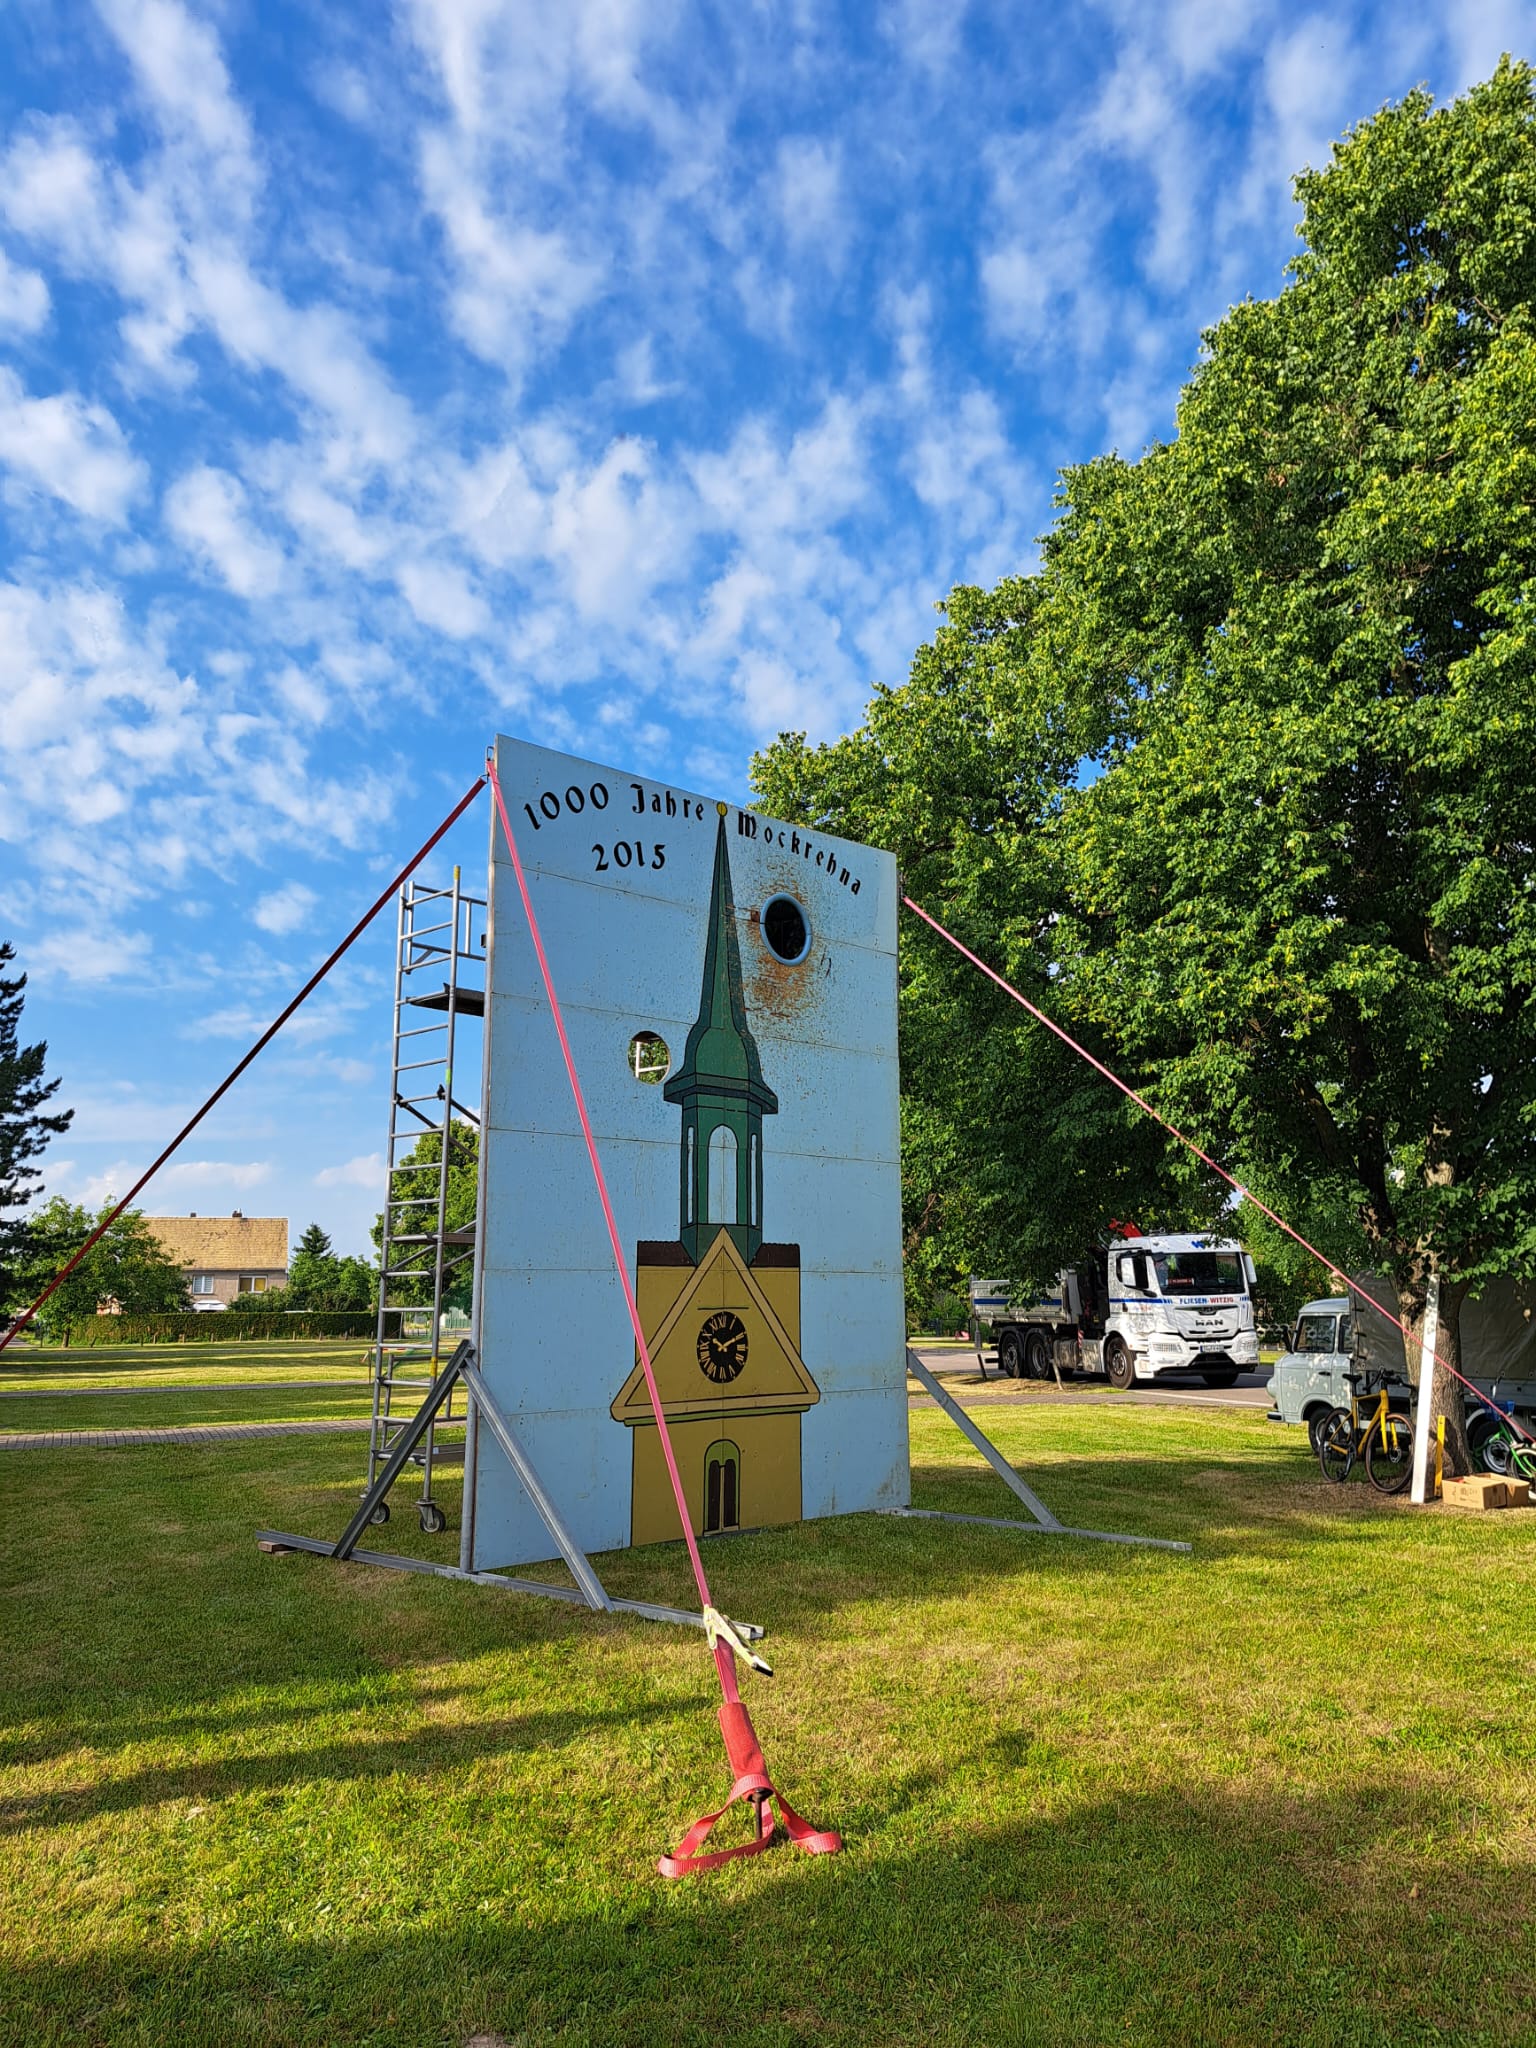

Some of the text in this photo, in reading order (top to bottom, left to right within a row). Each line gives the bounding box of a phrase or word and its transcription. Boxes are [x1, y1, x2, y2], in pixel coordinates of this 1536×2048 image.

[524, 782, 861, 895] 1000 Jahre Mockrehna
[592, 841, 666, 871] 2015
[1195, 1319, 1224, 1327] MAN
